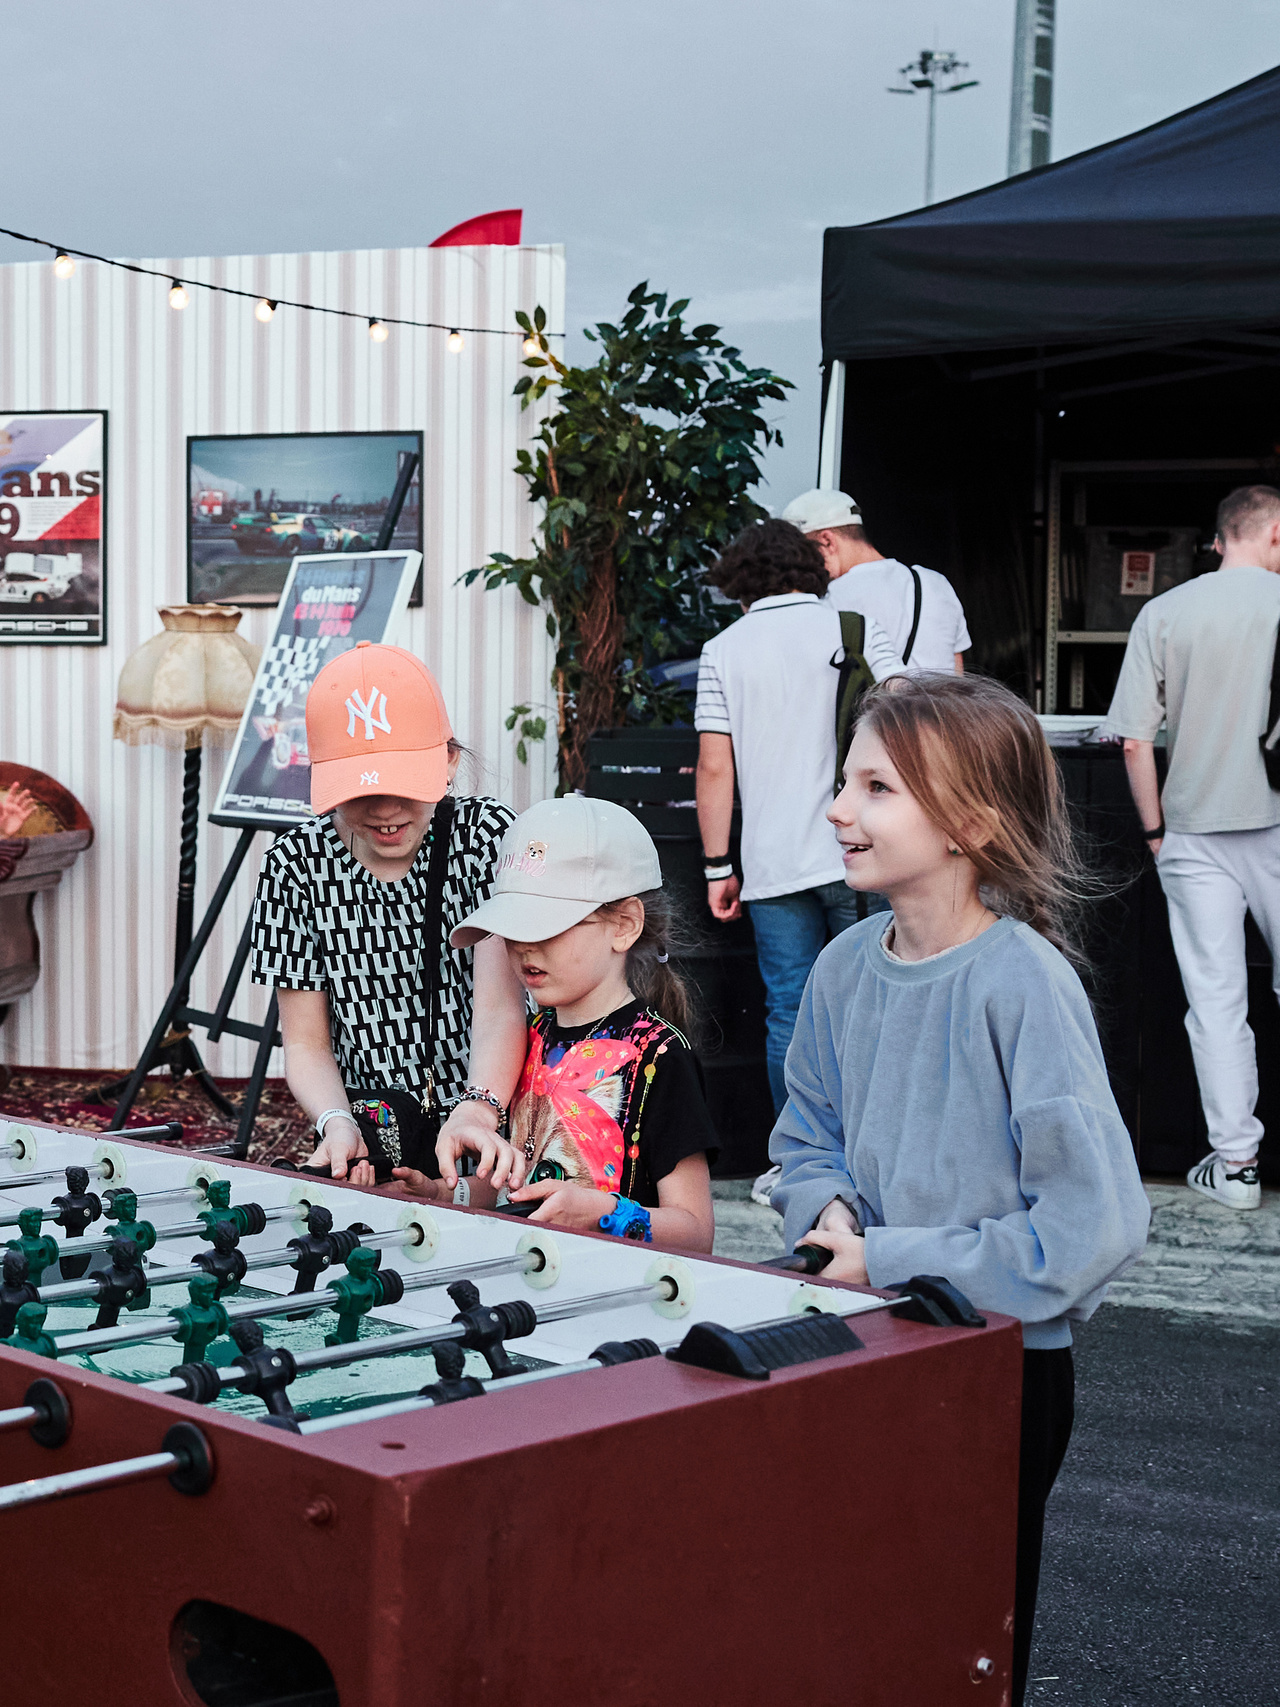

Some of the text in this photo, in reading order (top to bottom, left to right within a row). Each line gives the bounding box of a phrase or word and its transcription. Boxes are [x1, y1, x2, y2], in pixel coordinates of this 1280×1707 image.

[302, 585, 361, 603] du Mans
[344, 686, 392, 740] NY
[224, 794, 312, 814] PORSCH
